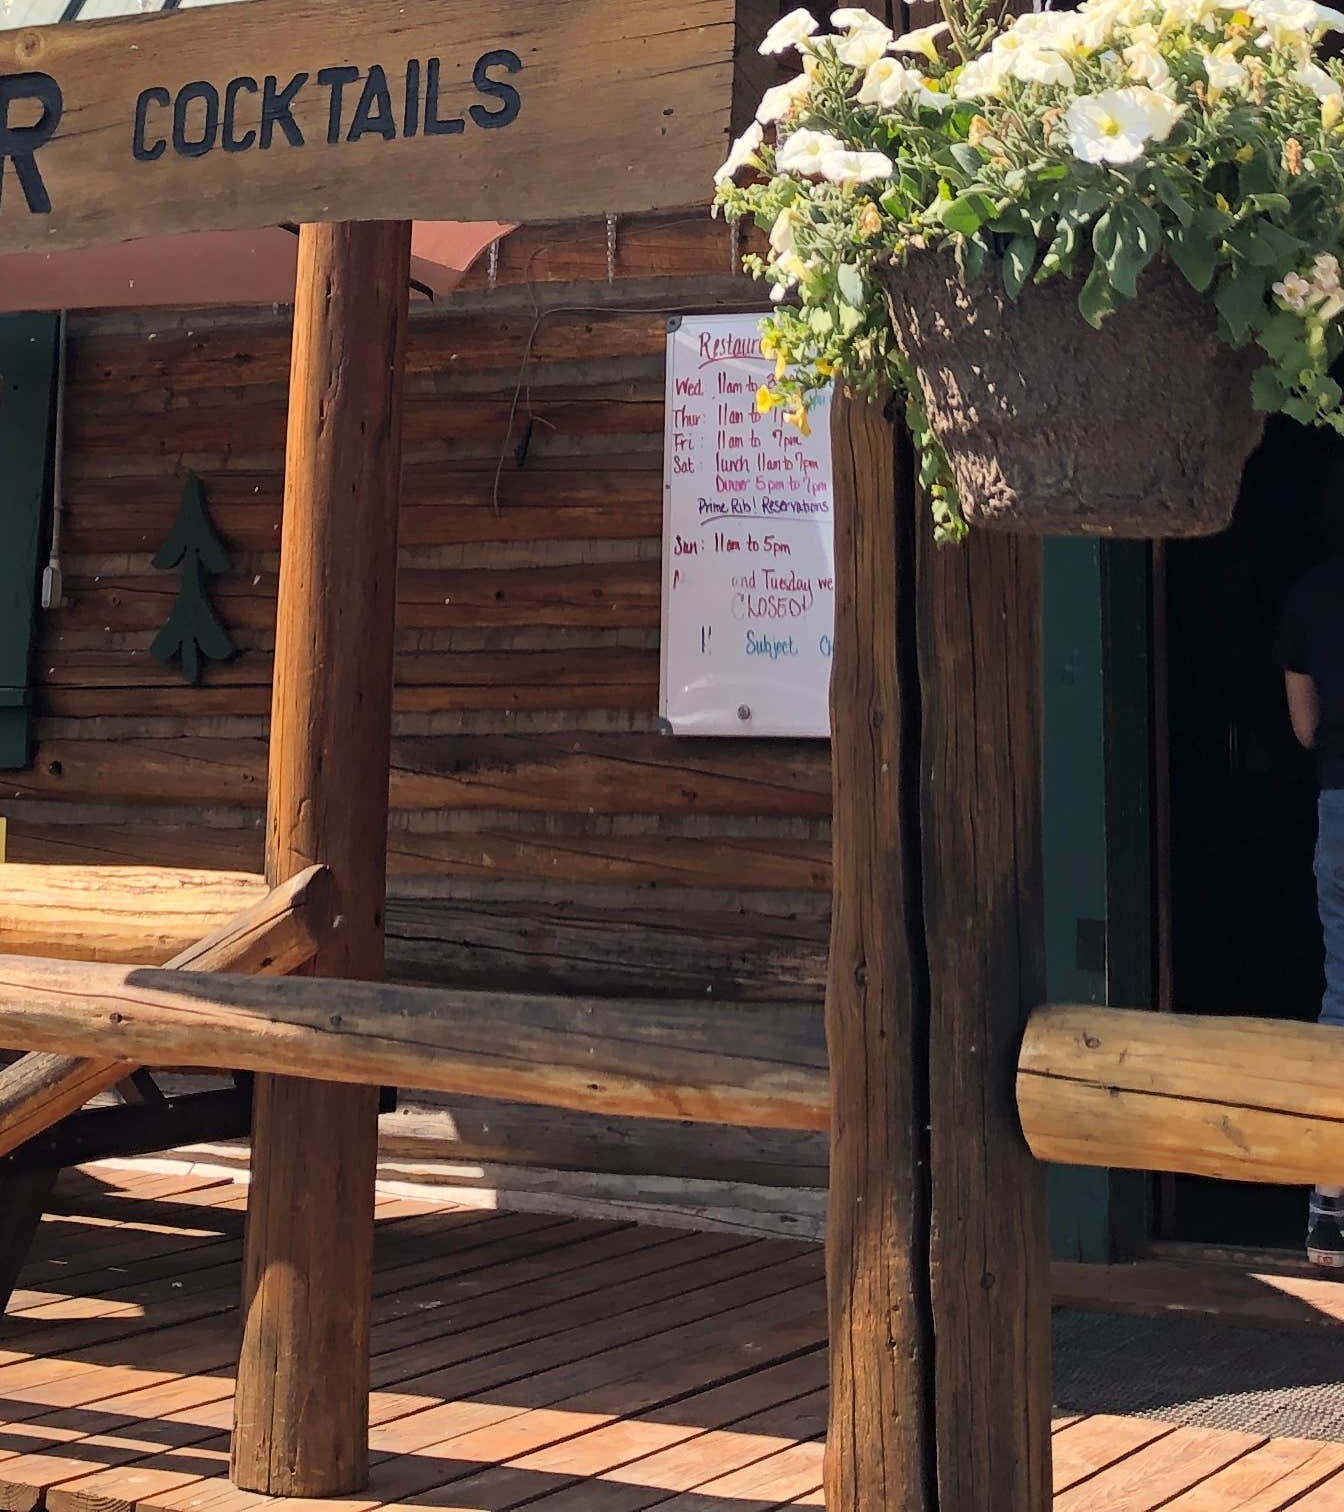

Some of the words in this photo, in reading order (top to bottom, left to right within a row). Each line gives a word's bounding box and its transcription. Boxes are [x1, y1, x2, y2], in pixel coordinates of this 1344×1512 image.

[132, 49, 524, 164] COCKTAILS
[750, 430, 762, 449] to
[698, 497, 729, 515] Prime
[762, 496, 829, 514] Reservations
